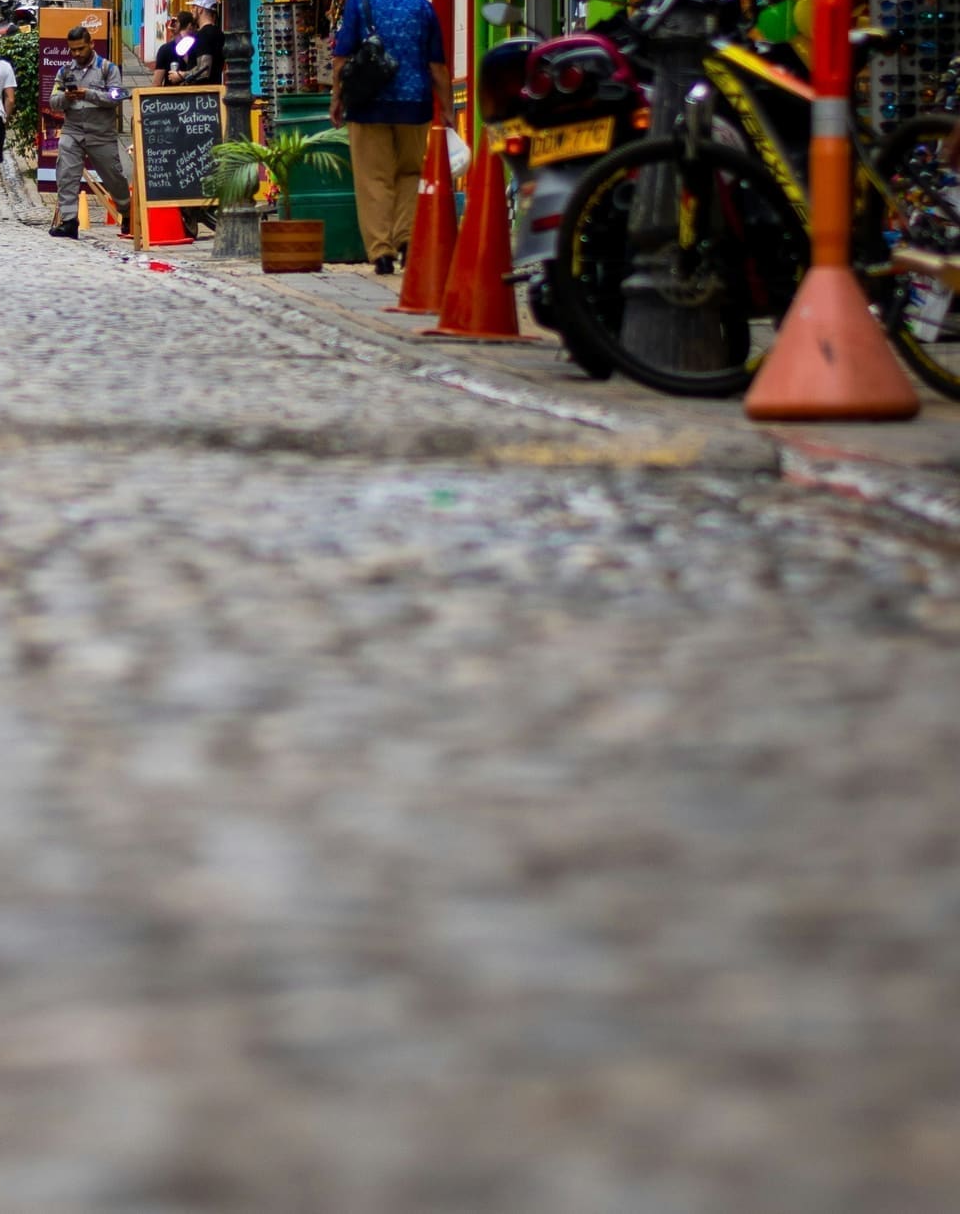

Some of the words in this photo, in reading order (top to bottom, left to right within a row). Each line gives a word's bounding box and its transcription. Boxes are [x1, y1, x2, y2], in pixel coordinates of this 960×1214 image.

[43, 46, 59, 56] Calle
[43, 58, 73, 67] Recuer
[141, 98, 190, 115] Getaway
[195, 95, 218, 110] Pub
[178, 112, 219, 124] National
[185, 124, 213, 135] BEER
